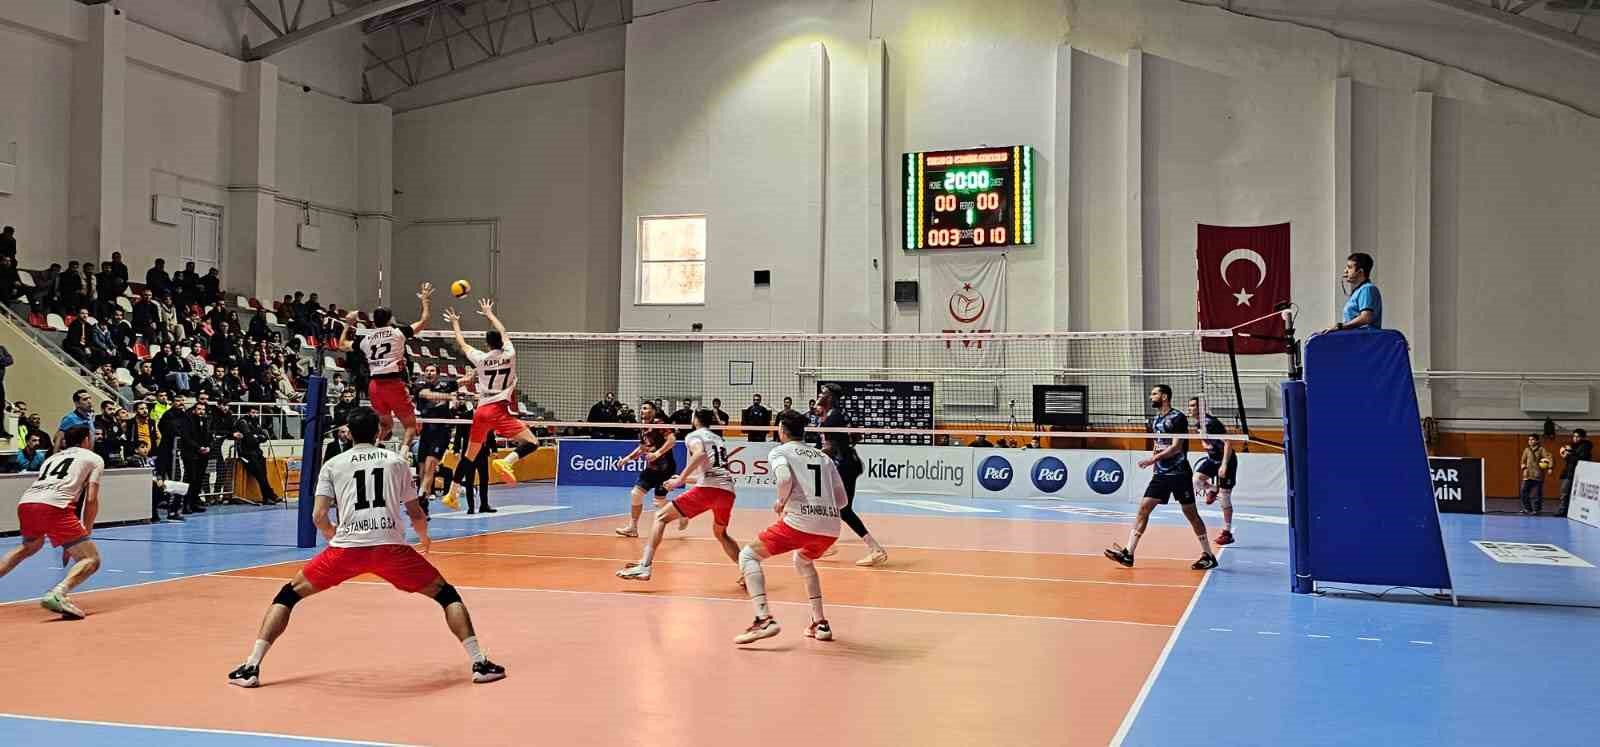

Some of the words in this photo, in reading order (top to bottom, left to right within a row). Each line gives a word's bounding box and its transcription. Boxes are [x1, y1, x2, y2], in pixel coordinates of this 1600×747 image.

[944, 170, 990, 191] 20:00
[935, 195, 956, 212] 00
[977, 193, 998, 210] 00
[928, 229, 960, 246] 003
[370, 343, 391, 361] 12
[484, 368, 511, 390] 77
[351, 452, 388, 462] ARMIN
[39, 457, 75, 481] 14
[984, 467, 1010, 480] P&G
[1037, 467, 1065, 481] P&G
[1093, 470, 1121, 483] P&G
[807, 464, 822, 497] 7
[353, 468, 386, 511] 11
